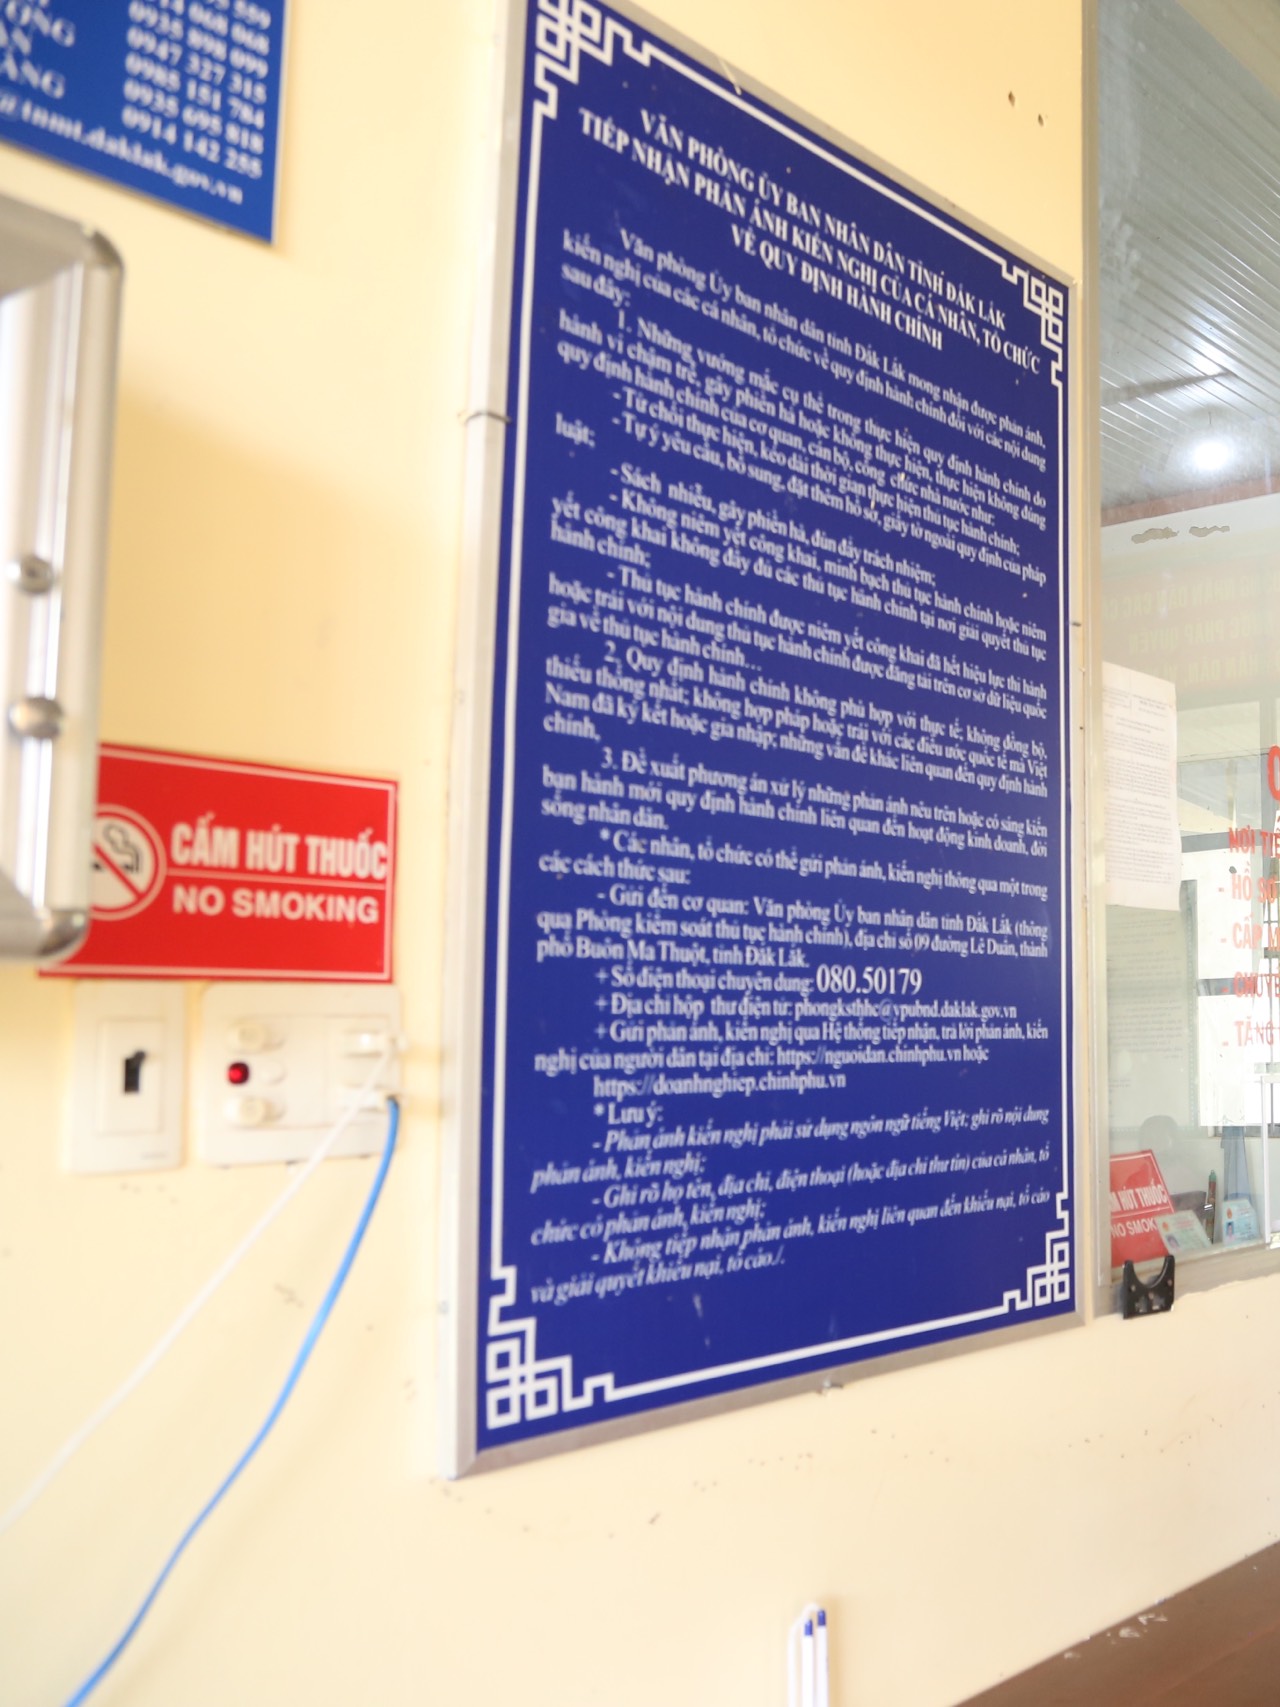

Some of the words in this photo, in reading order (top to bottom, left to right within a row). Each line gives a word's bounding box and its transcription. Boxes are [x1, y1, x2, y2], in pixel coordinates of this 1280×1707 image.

[641, 109, 683, 151] VĂN
[688, 137, 754, 191] PHÒNG
[787, 192, 820, 227] BAN
[825, 213, 869, 254] NHÂN
[874, 241, 904, 274] DÂN
[632, 138, 689, 188] NHẬN
[750, 201, 788, 241] ÁNH
[792, 226, 833, 264] KIẾN
[837, 250, 877, 293] NGHỊ
[880, 275, 912, 307] CỦA
[914, 293, 934, 319] CÁ
[937, 304, 980, 345] NHÂN,
[1003, 341, 1040, 374] CHỨC
[759, 240, 797, 275] QUY
[801, 261, 842, 300] ĐỊNH
[847, 284, 891, 324] HÀNH
[894, 311, 942, 350] CHÍNH
[170, 812, 240, 870] CẤM
[245, 823, 301, 875] HÚT
[305, 828, 388, 881] THUỐC
[1228, 825, 1255, 854] NƠI
[172, 885, 226, 917] NO
[231, 888, 379, 925] SMOKING
[635, 967, 673, 992] điện
[676, 969, 716, 993] thoại
[715, 970, 772, 997] chuyên
[816, 964, 922, 994] 080.50179
[611, 992, 645, 1018] Địa
[673, 994, 704, 1020] hộp
[711, 996, 739, 1015] thư
[738, 996, 771, 1020] điện
[1118, 1186, 1138, 1211] HÚT
[1136, 1178, 1168, 1207] THUỐC
[1111, 1224, 1126, 1238] NO
[1126, 1218, 1158, 1236] SMOK
